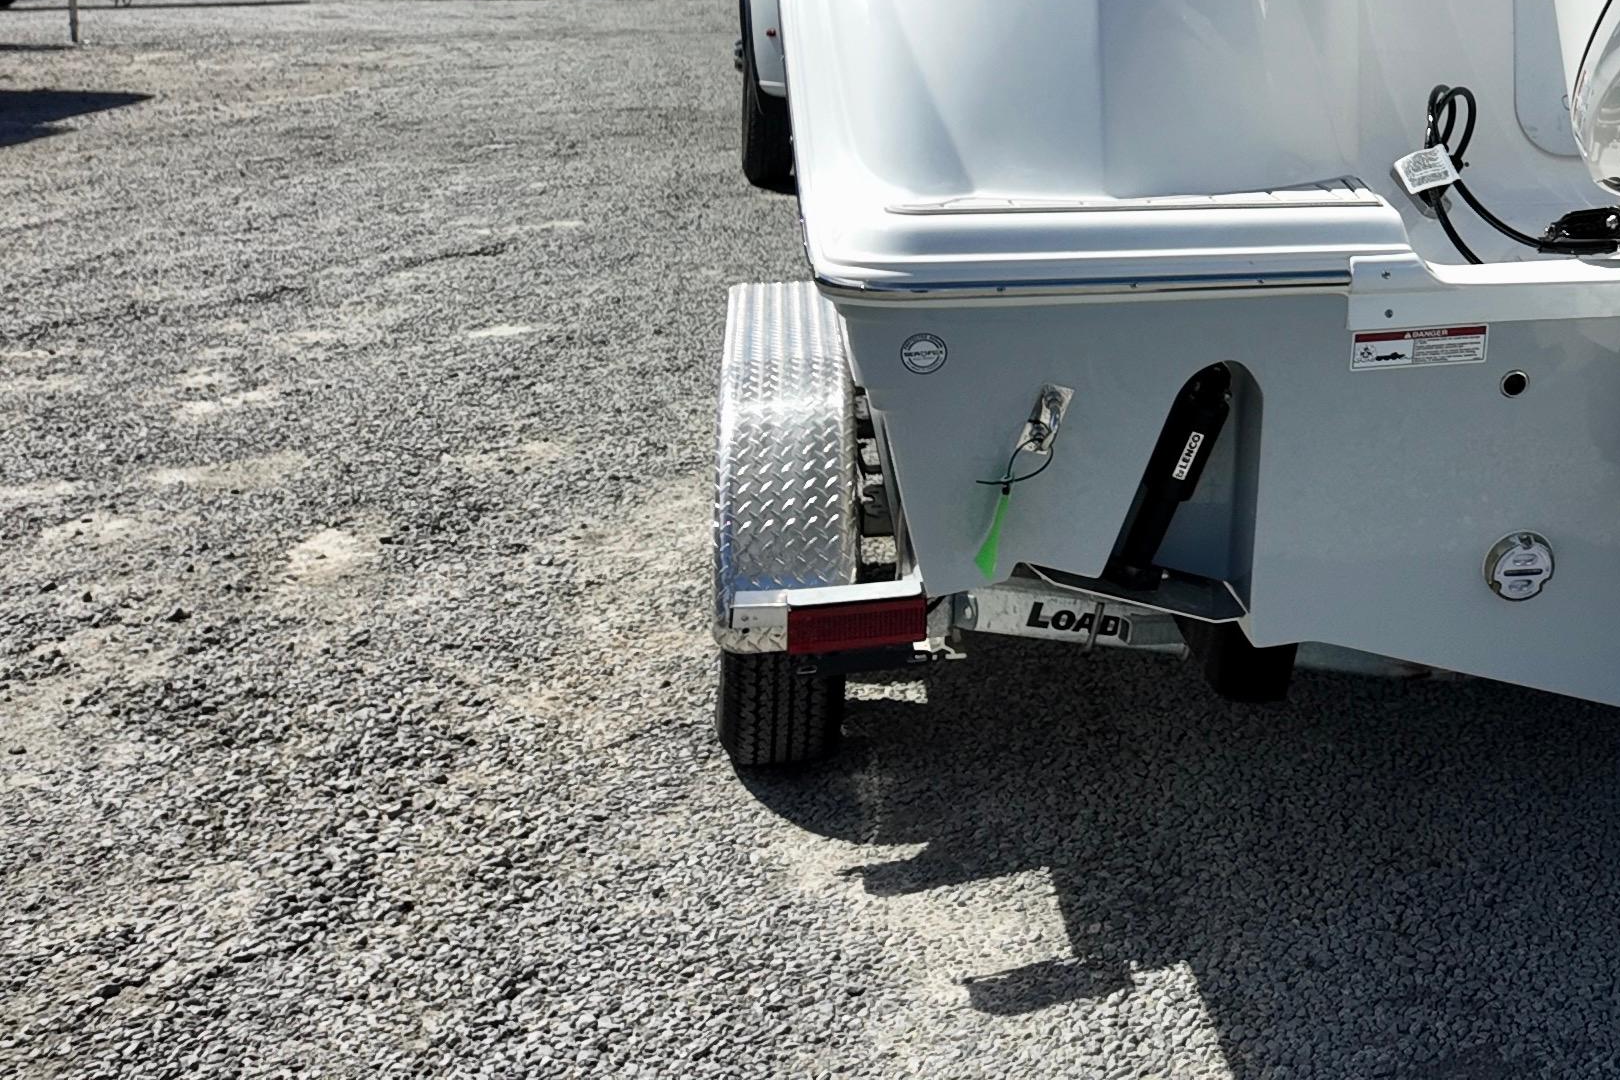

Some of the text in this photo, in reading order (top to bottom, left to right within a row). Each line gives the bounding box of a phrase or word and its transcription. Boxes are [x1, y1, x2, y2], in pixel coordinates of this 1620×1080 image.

[1412, 328, 1449, 338] DANGER
[1178, 433, 1201, 470] LENCO
[1025, 601, 1121, 637] LOAD
